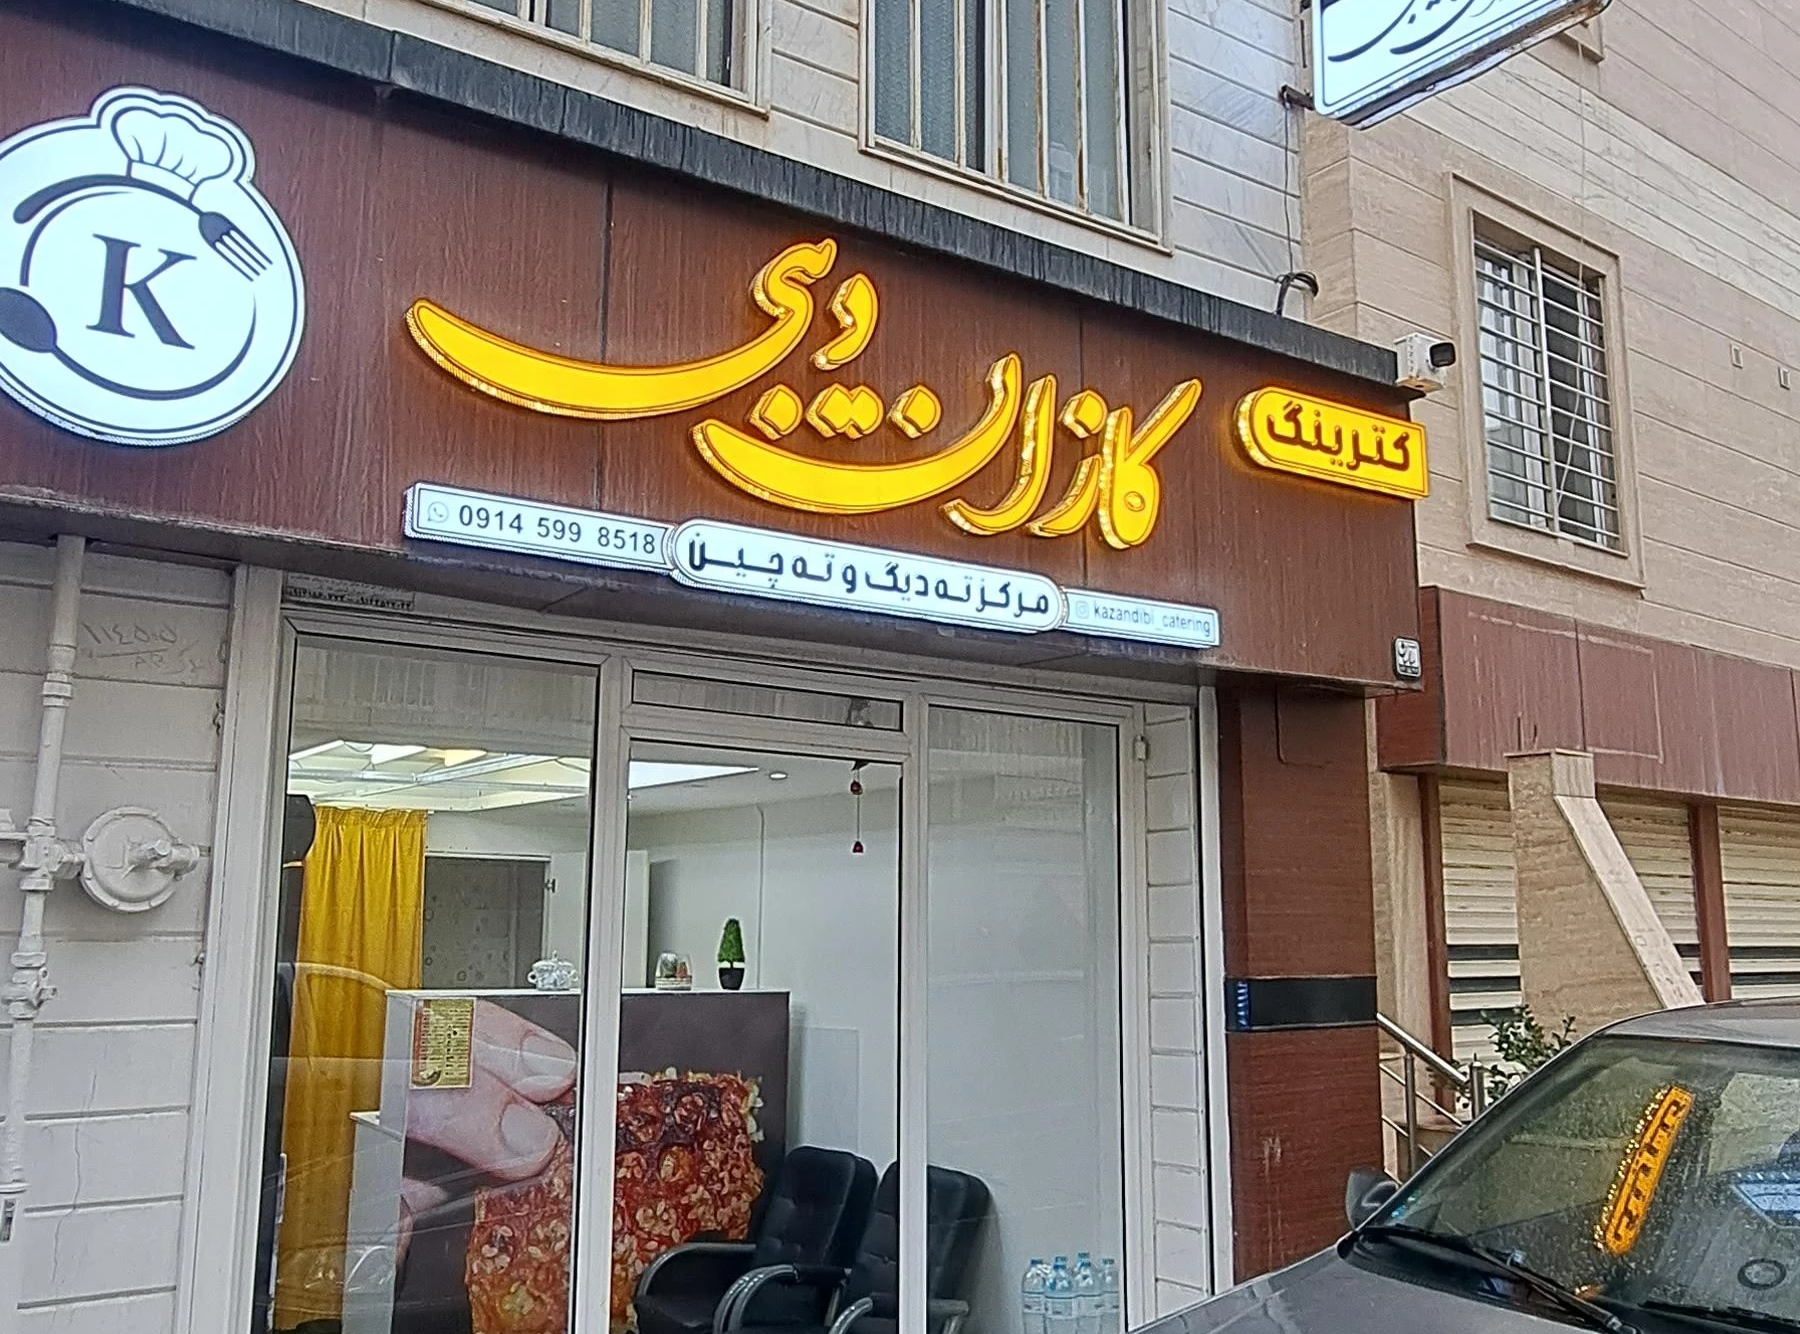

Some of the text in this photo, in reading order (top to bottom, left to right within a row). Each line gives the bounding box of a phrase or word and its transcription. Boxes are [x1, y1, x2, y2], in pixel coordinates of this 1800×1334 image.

[86, 232, 197, 351] K
[1266, 402, 1411, 472] کترینگ
[458, 504, 657, 555] 0914 599 8518
[842, 563, 857, 594] و
[975, 578, 1049, 618] مرکز
